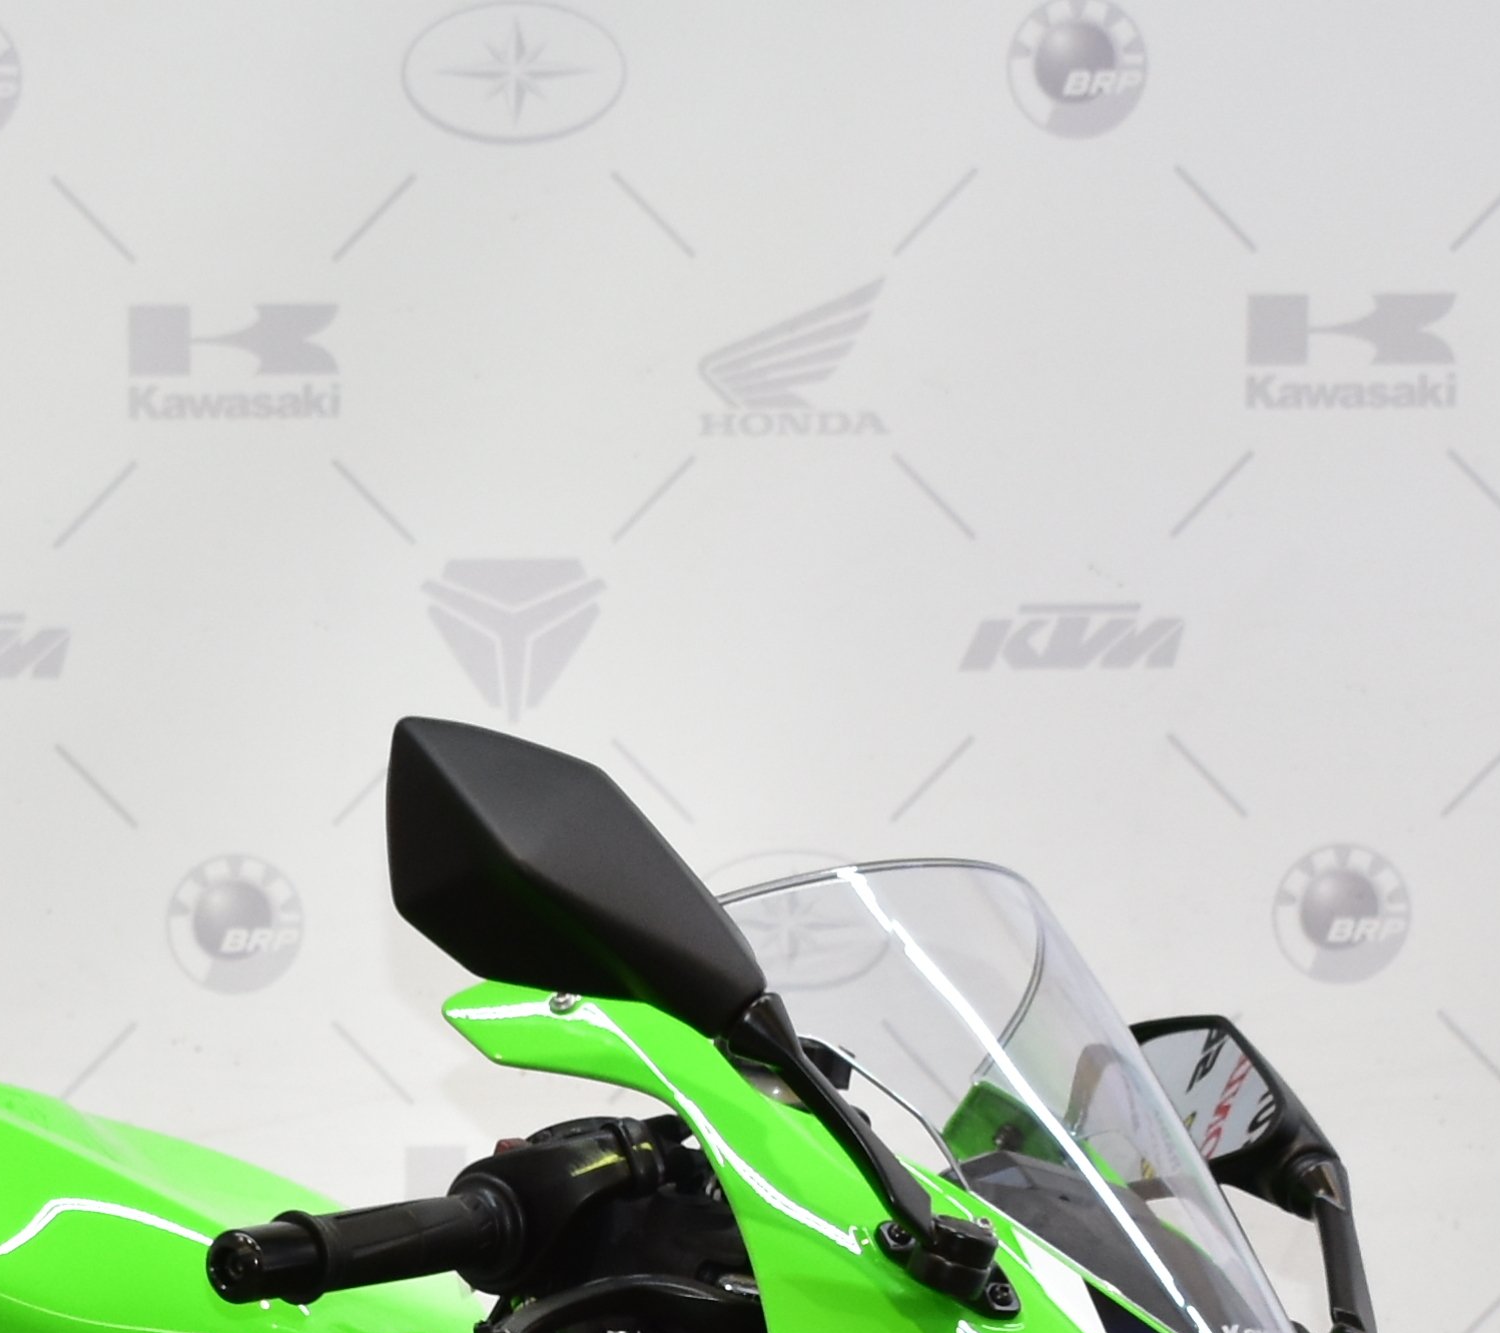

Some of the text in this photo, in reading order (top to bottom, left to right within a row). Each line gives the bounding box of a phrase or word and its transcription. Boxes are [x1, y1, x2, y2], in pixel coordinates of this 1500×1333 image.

[1063, 70, 1141, 96] BRP
[128, 383, 341, 419] Kawasaki
[1246, 373, 1457, 409] Kawasaki
[700, 411, 889, 437] HONDA
[960, 602, 1184, 670] KTM
[219, 930, 300, 954] BRP
[1327, 919, 1407, 944] BRP
